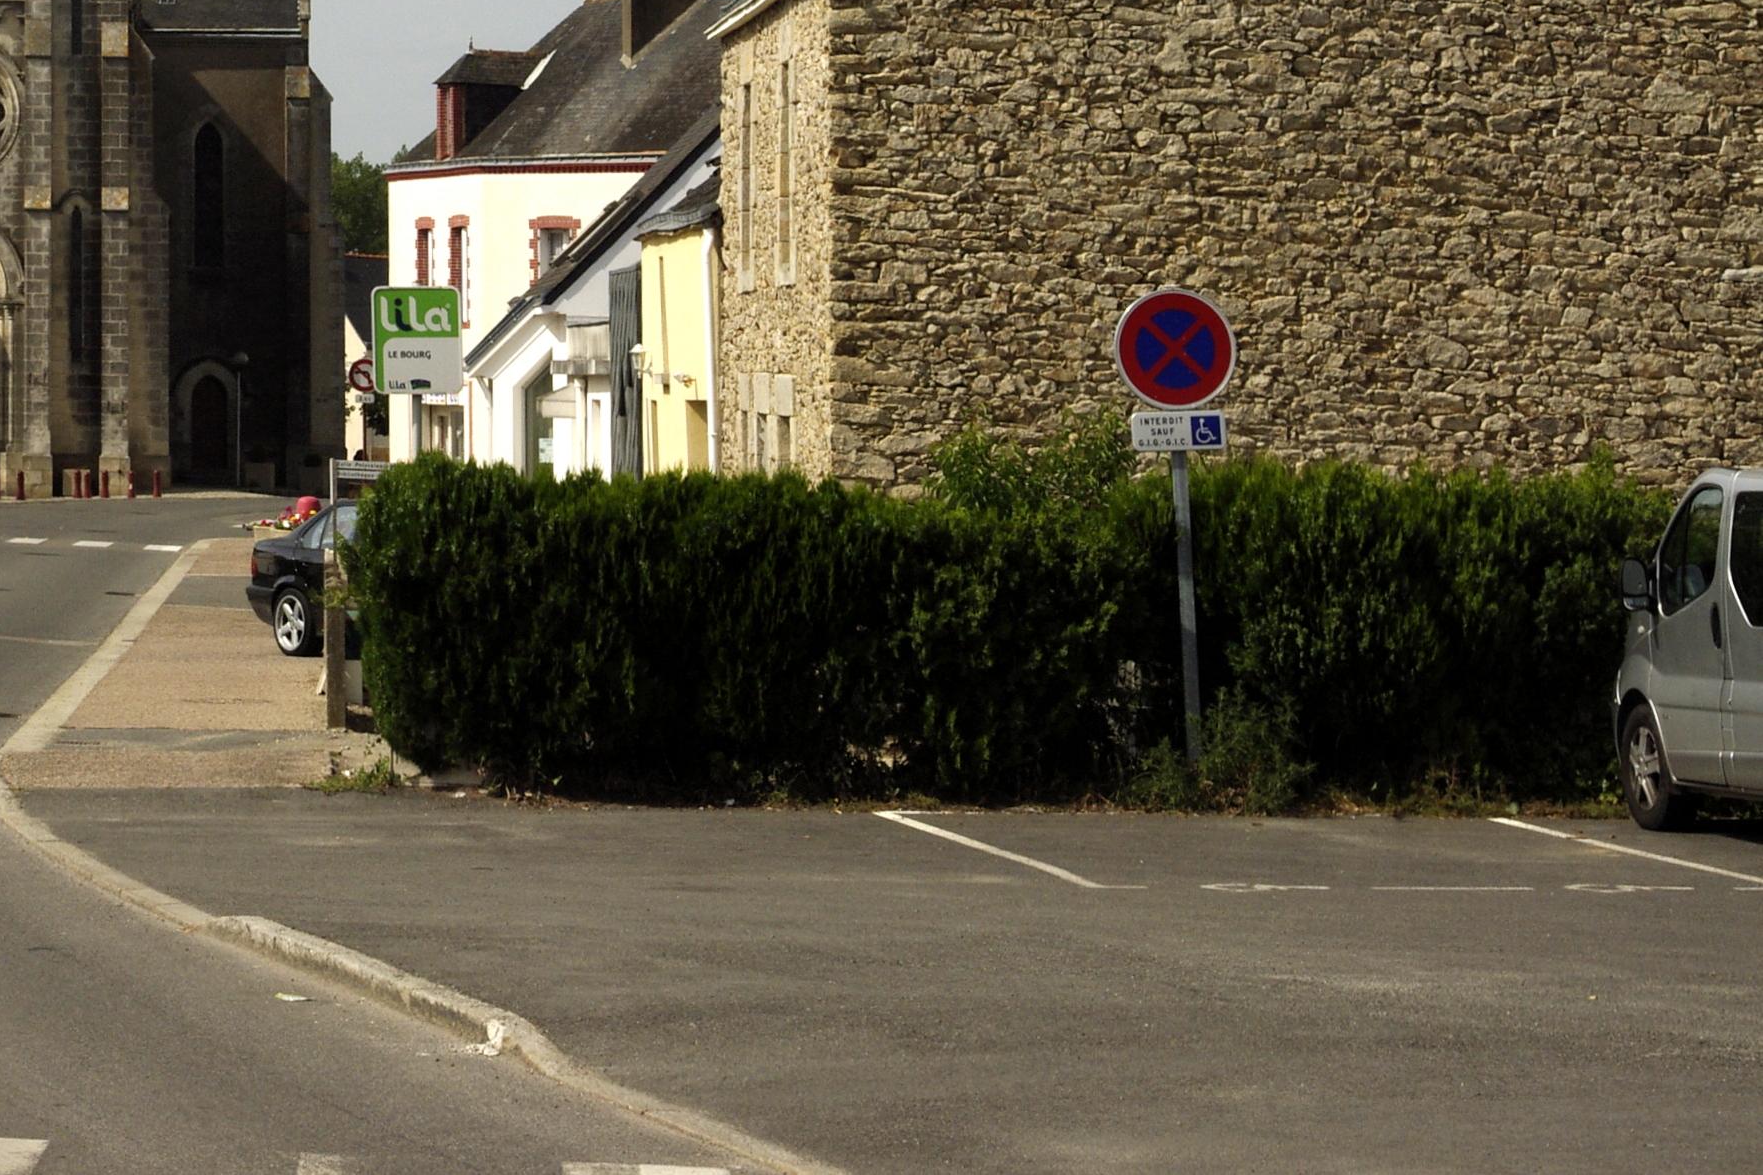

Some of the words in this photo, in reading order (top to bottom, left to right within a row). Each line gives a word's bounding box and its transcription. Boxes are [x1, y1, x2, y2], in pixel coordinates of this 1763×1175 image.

[400, 350, 432, 359] BOURG
[1140, 416, 1184, 426] INTERDIT
[1151, 428, 1174, 436] SAUF
